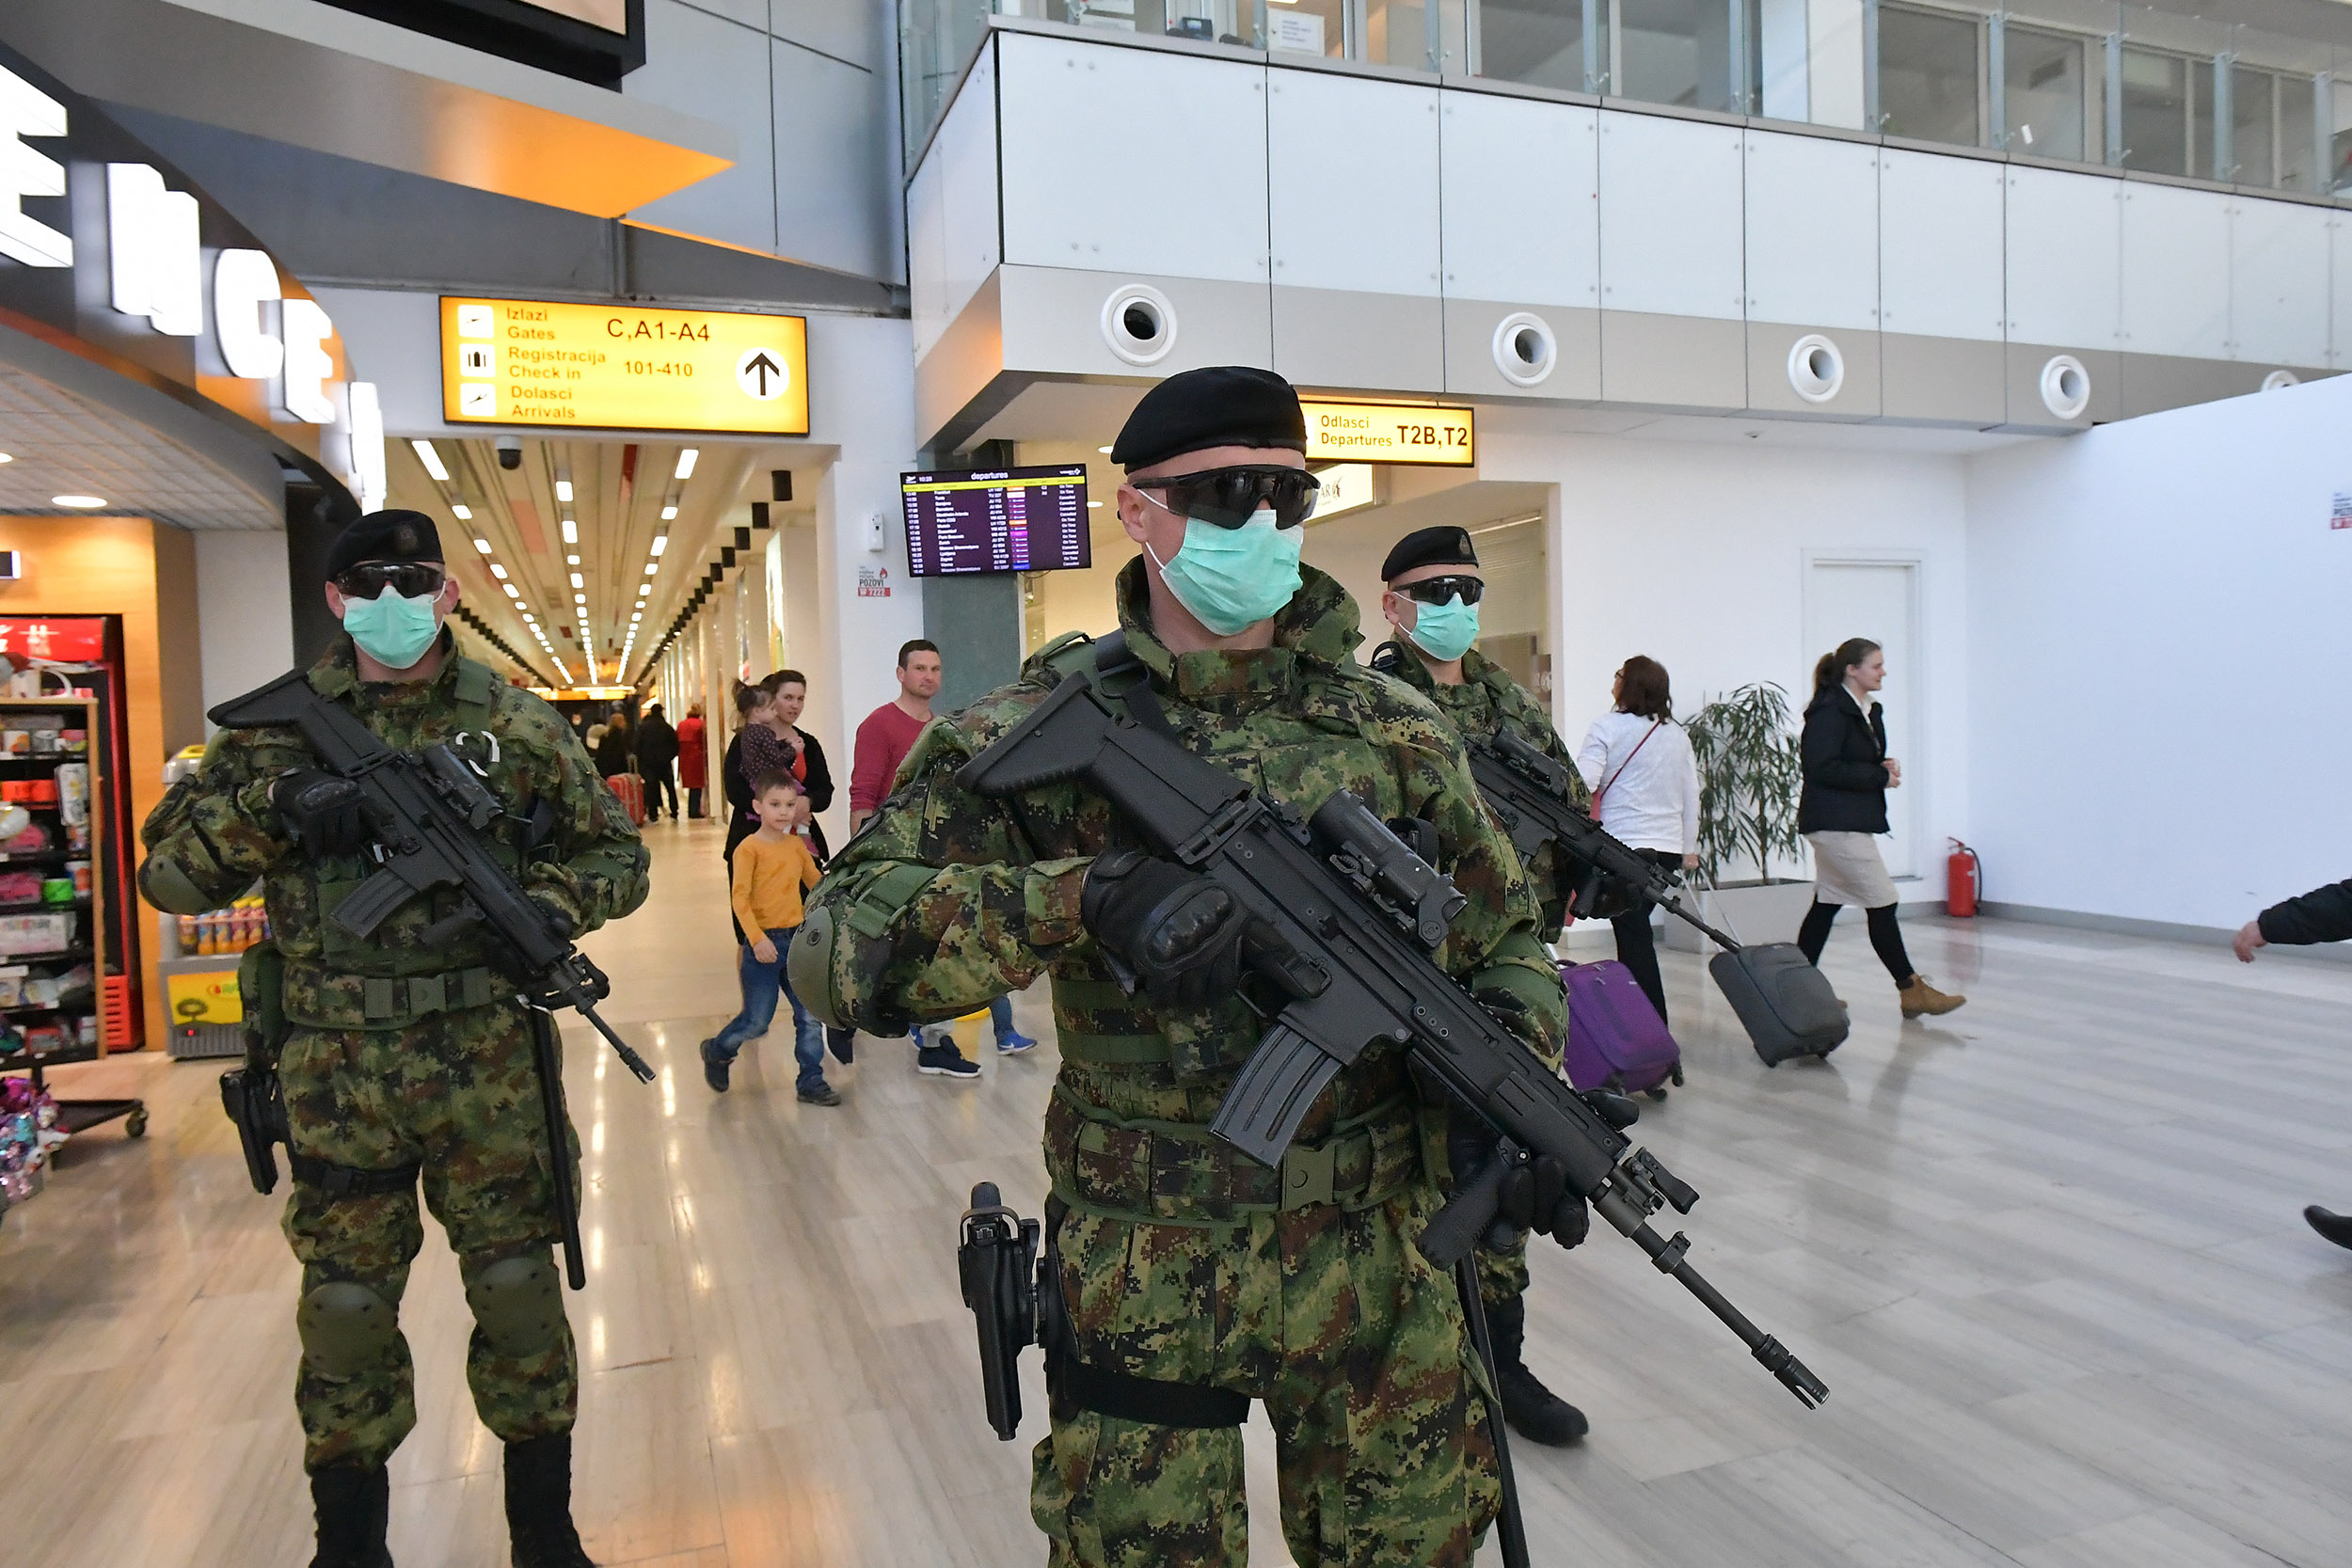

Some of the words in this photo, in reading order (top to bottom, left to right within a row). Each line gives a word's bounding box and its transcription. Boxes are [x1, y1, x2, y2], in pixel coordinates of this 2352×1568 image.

[506, 308, 548, 323] Izlazi
[507, 326, 556, 341] Gates
[607, 318, 711, 342] C,A1-A4
[508, 347, 607, 365] Registracija
[509, 365, 561, 380] Check
[566, 367, 581, 381] in
[625, 361, 693, 377] 101-410
[511, 386, 573, 401] Dolasci
[511, 404, 576, 420] Arrivals
[1321, 415, 1370, 429] Odlasci
[1321, 433, 1392, 448] Departures
[1397, 425, 1468, 450] T2B,T2
[971, 472, 1009, 482] departures
[859, 578, 884, 587] POZOVI
